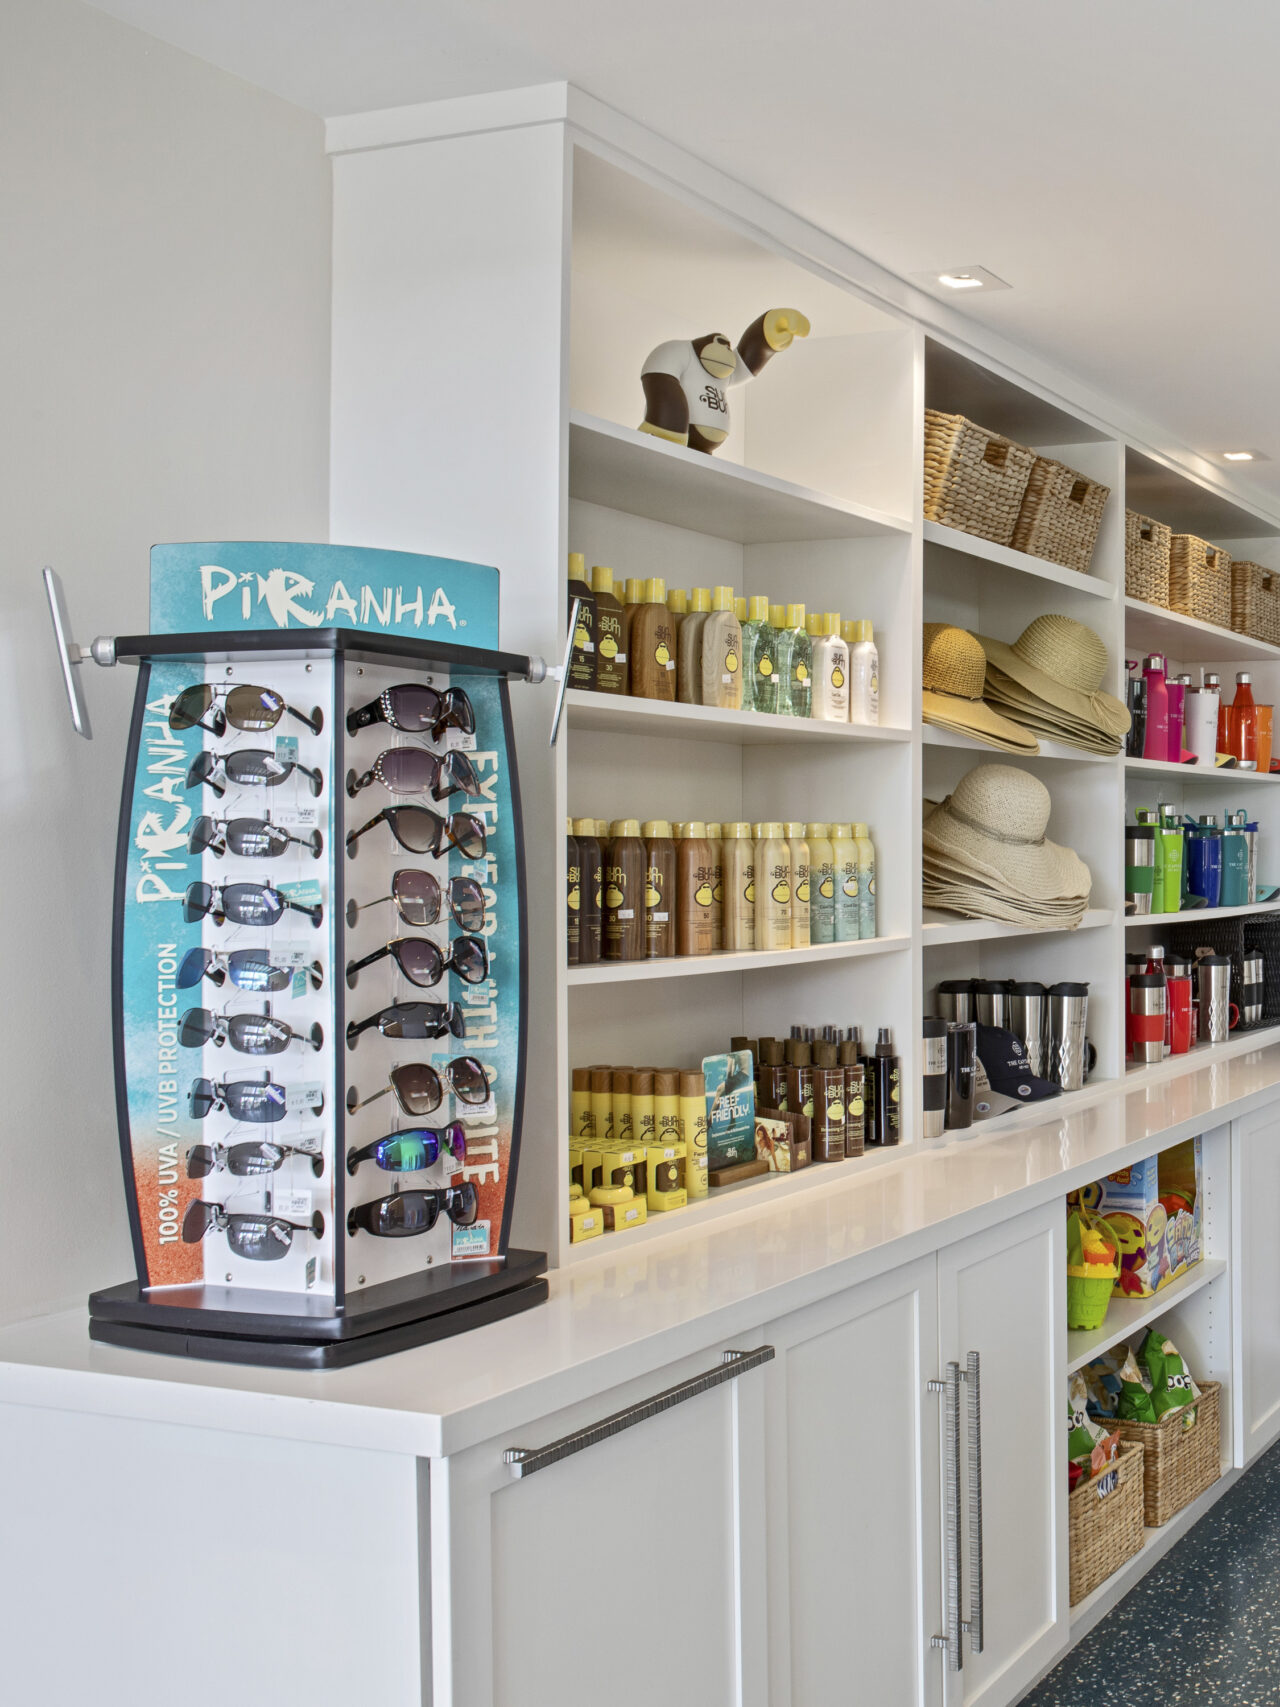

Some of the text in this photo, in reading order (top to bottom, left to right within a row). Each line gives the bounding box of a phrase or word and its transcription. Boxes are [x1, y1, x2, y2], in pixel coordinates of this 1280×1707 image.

[200, 565, 458, 628] PiRANHA
[600, 622, 621, 637] Bum
[602, 616, 617, 624] Sun
[157, 943, 178, 1074] PROTECTION
[158, 1081, 178, 1124] UVB
[711, 1104, 750, 1124] FRIENDLY
[719, 1094, 740, 1109] REEF
[158, 1142, 179, 1185] UVA
[158, 1189, 179, 1245] 100%
